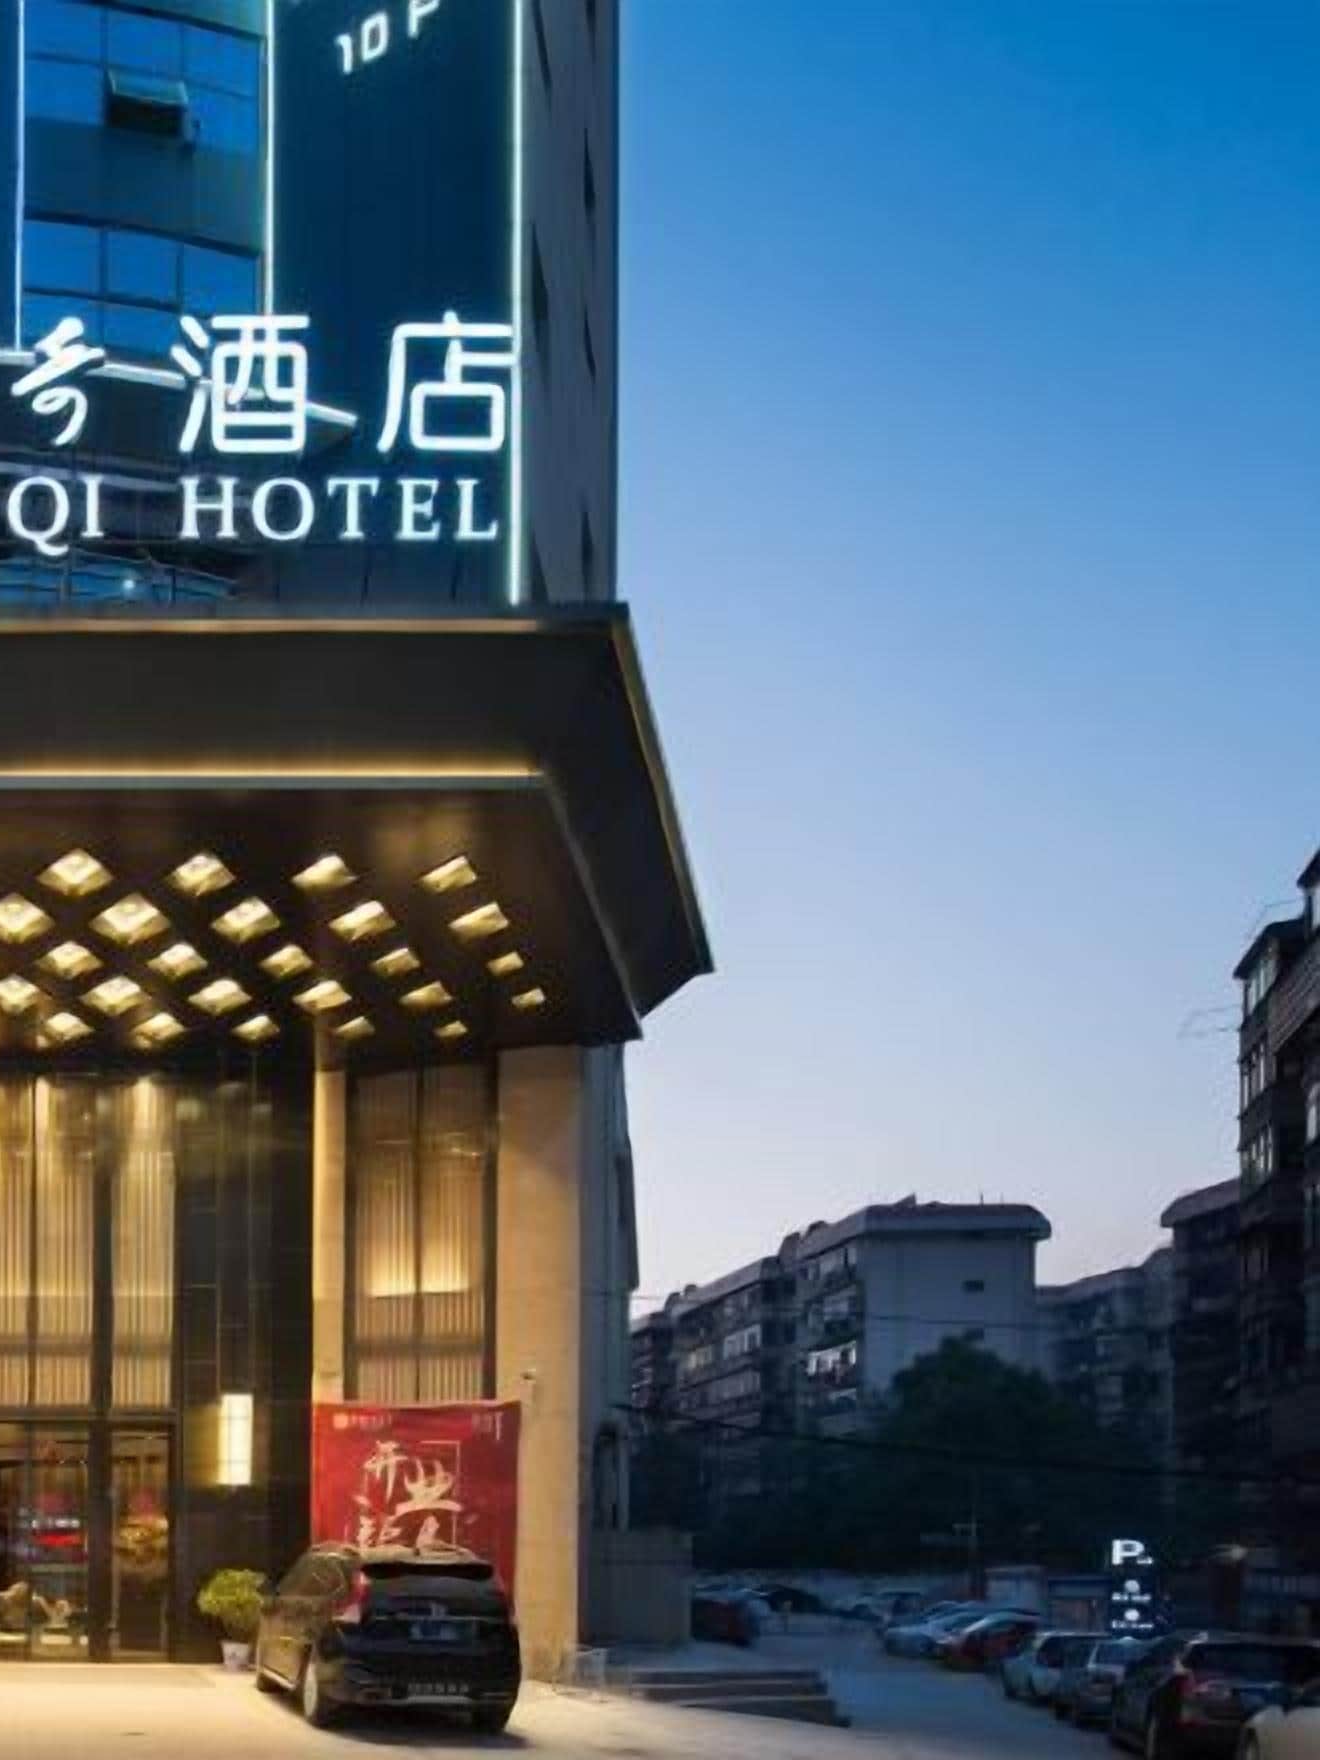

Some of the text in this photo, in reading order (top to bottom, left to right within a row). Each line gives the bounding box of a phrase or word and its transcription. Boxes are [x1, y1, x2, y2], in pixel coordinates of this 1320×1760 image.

[6, 475, 106, 557] QI
[179, 475, 499, 541] HOTEL
[1111, 1539, 1145, 1566] P
